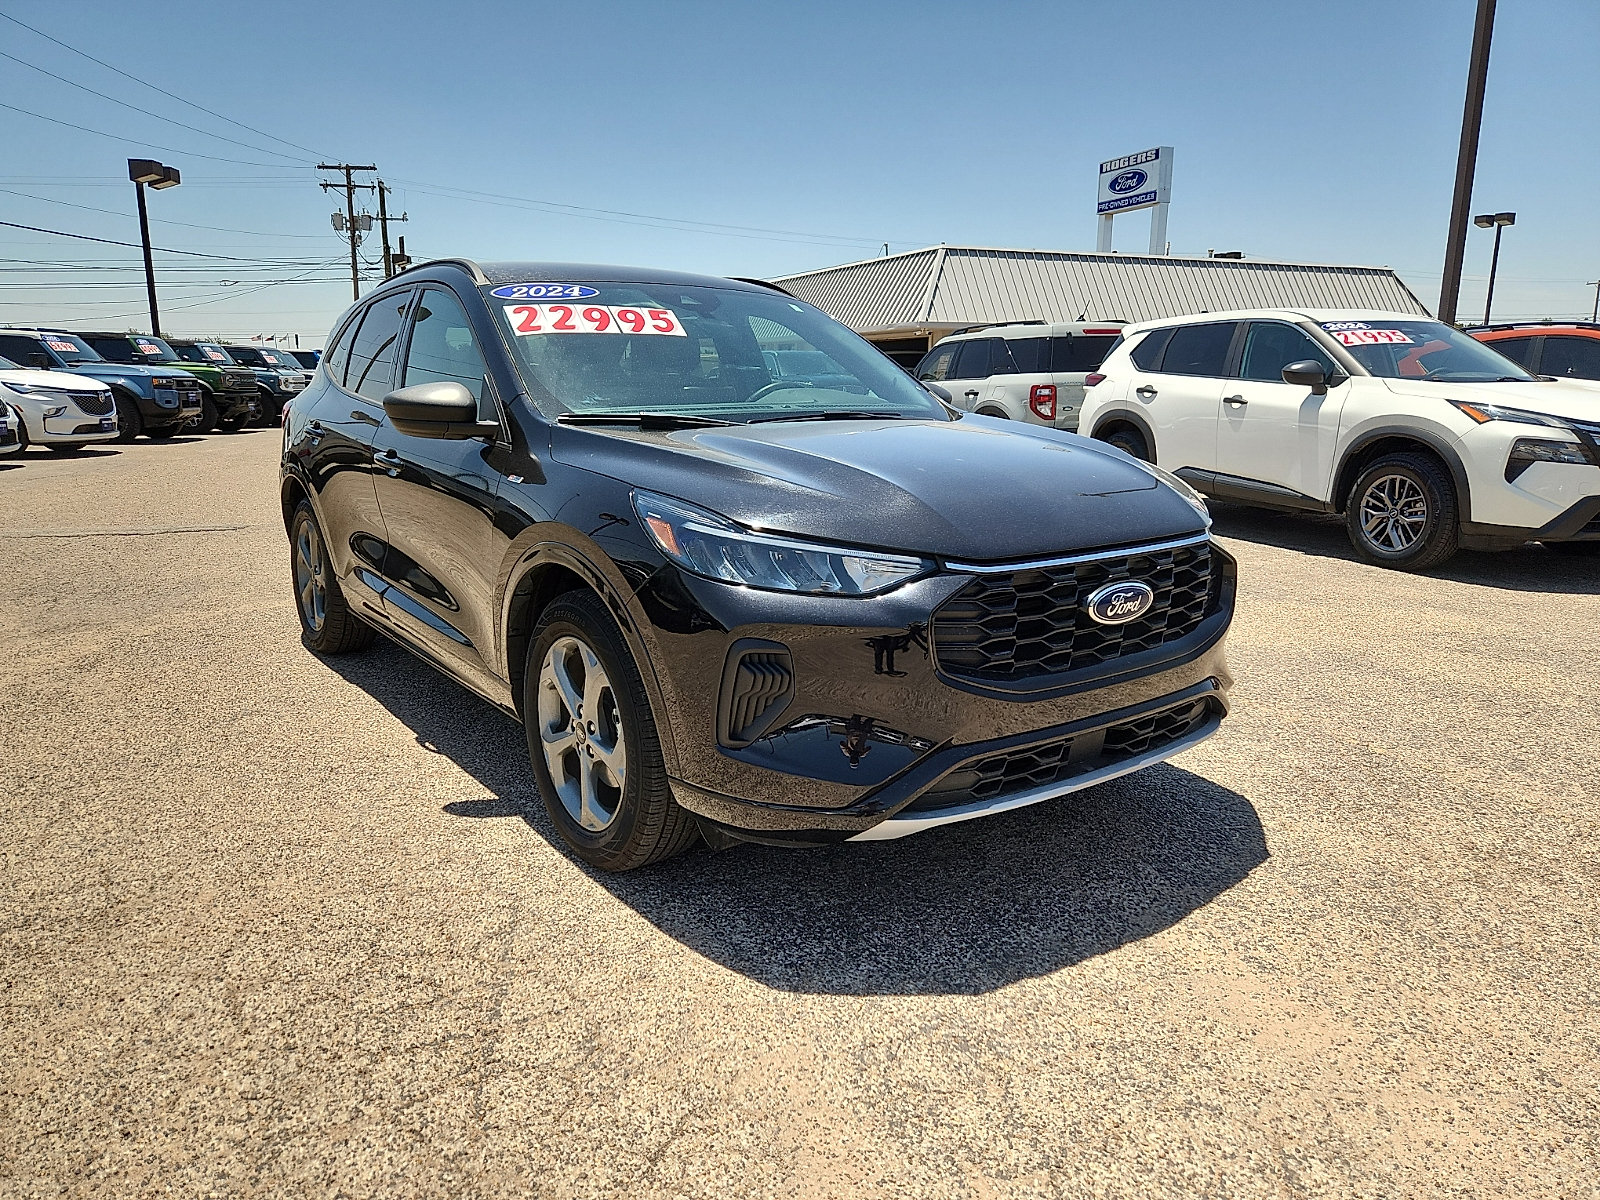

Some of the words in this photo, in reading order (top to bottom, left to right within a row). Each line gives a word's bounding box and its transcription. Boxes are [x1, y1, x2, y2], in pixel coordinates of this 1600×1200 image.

[1102, 150, 1156, 173] ROGERS
[1115, 173, 1139, 191] Ford
[1098, 199, 1129, 211] PRE-OWNED
[1129, 192, 1155, 205] VEHICLES
[511, 286, 582, 298] 2024
[512, 306, 675, 332] 22995
[1336, 331, 1408, 345] 21995
[1106, 591, 1142, 617] Ford
